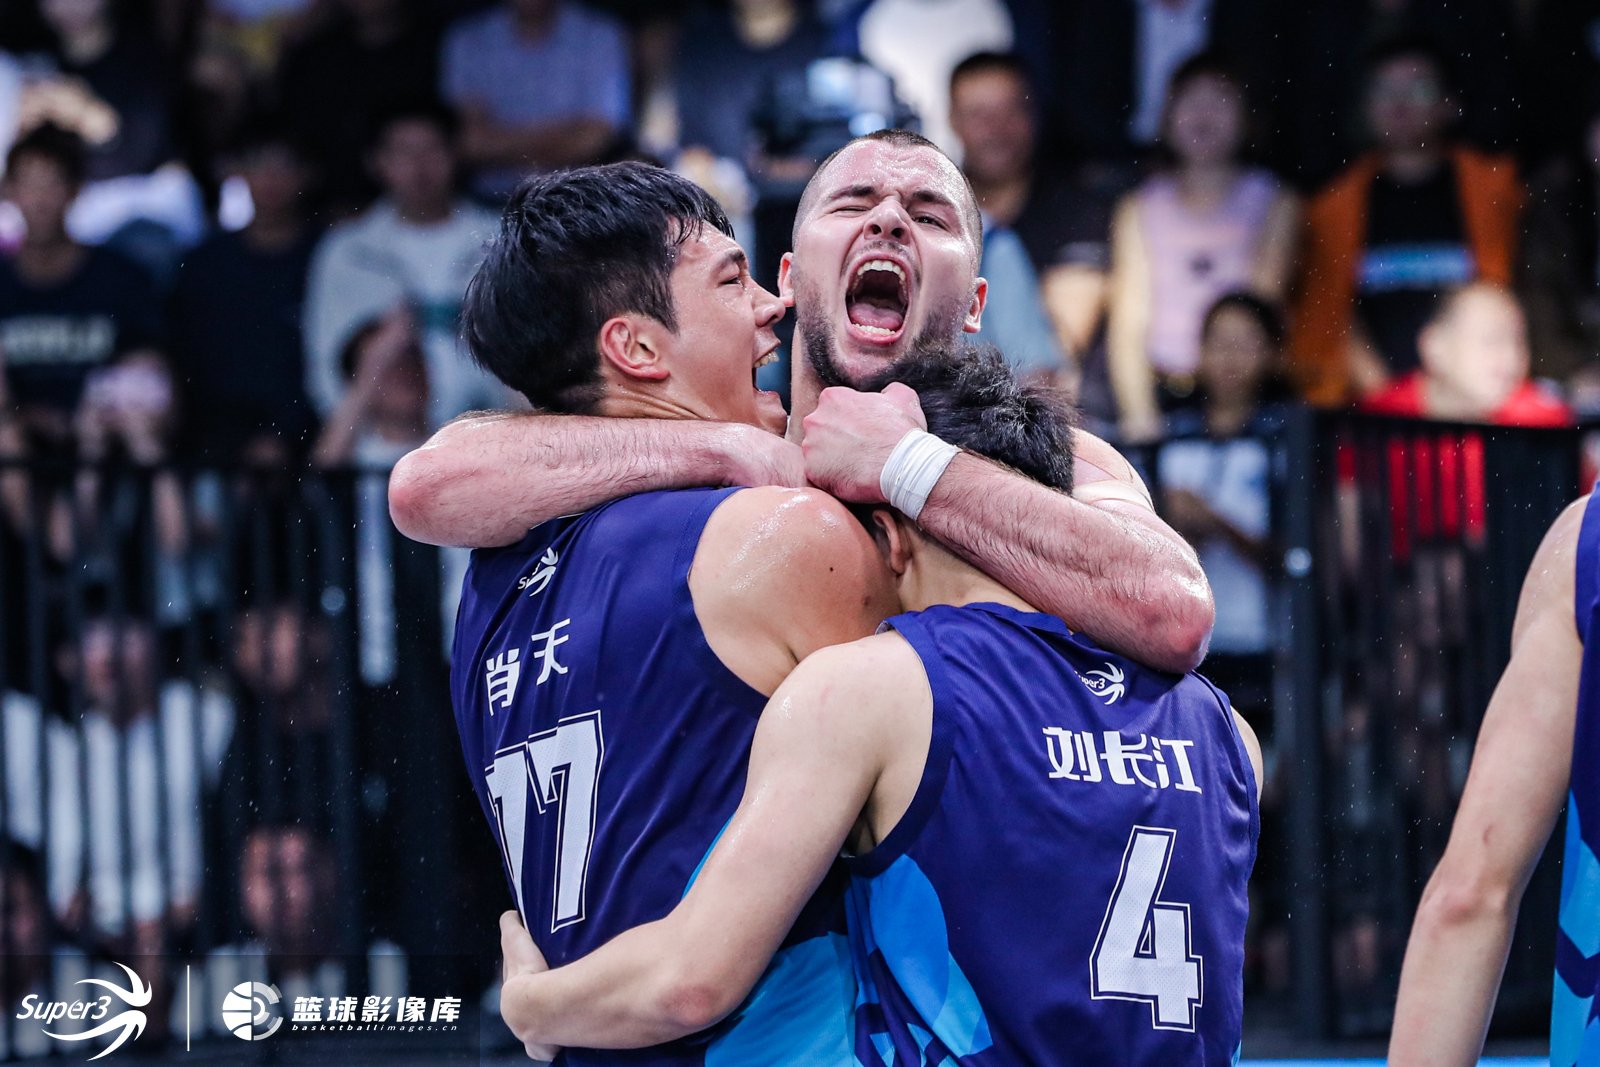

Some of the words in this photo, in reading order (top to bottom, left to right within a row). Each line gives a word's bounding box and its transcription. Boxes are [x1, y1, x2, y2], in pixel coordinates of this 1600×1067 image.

[485, 617, 571, 717] 肖天
[484, 709, 605, 934] 77
[1042, 726, 1202, 794] 刘长江
[1089, 824, 1204, 1033] 4
